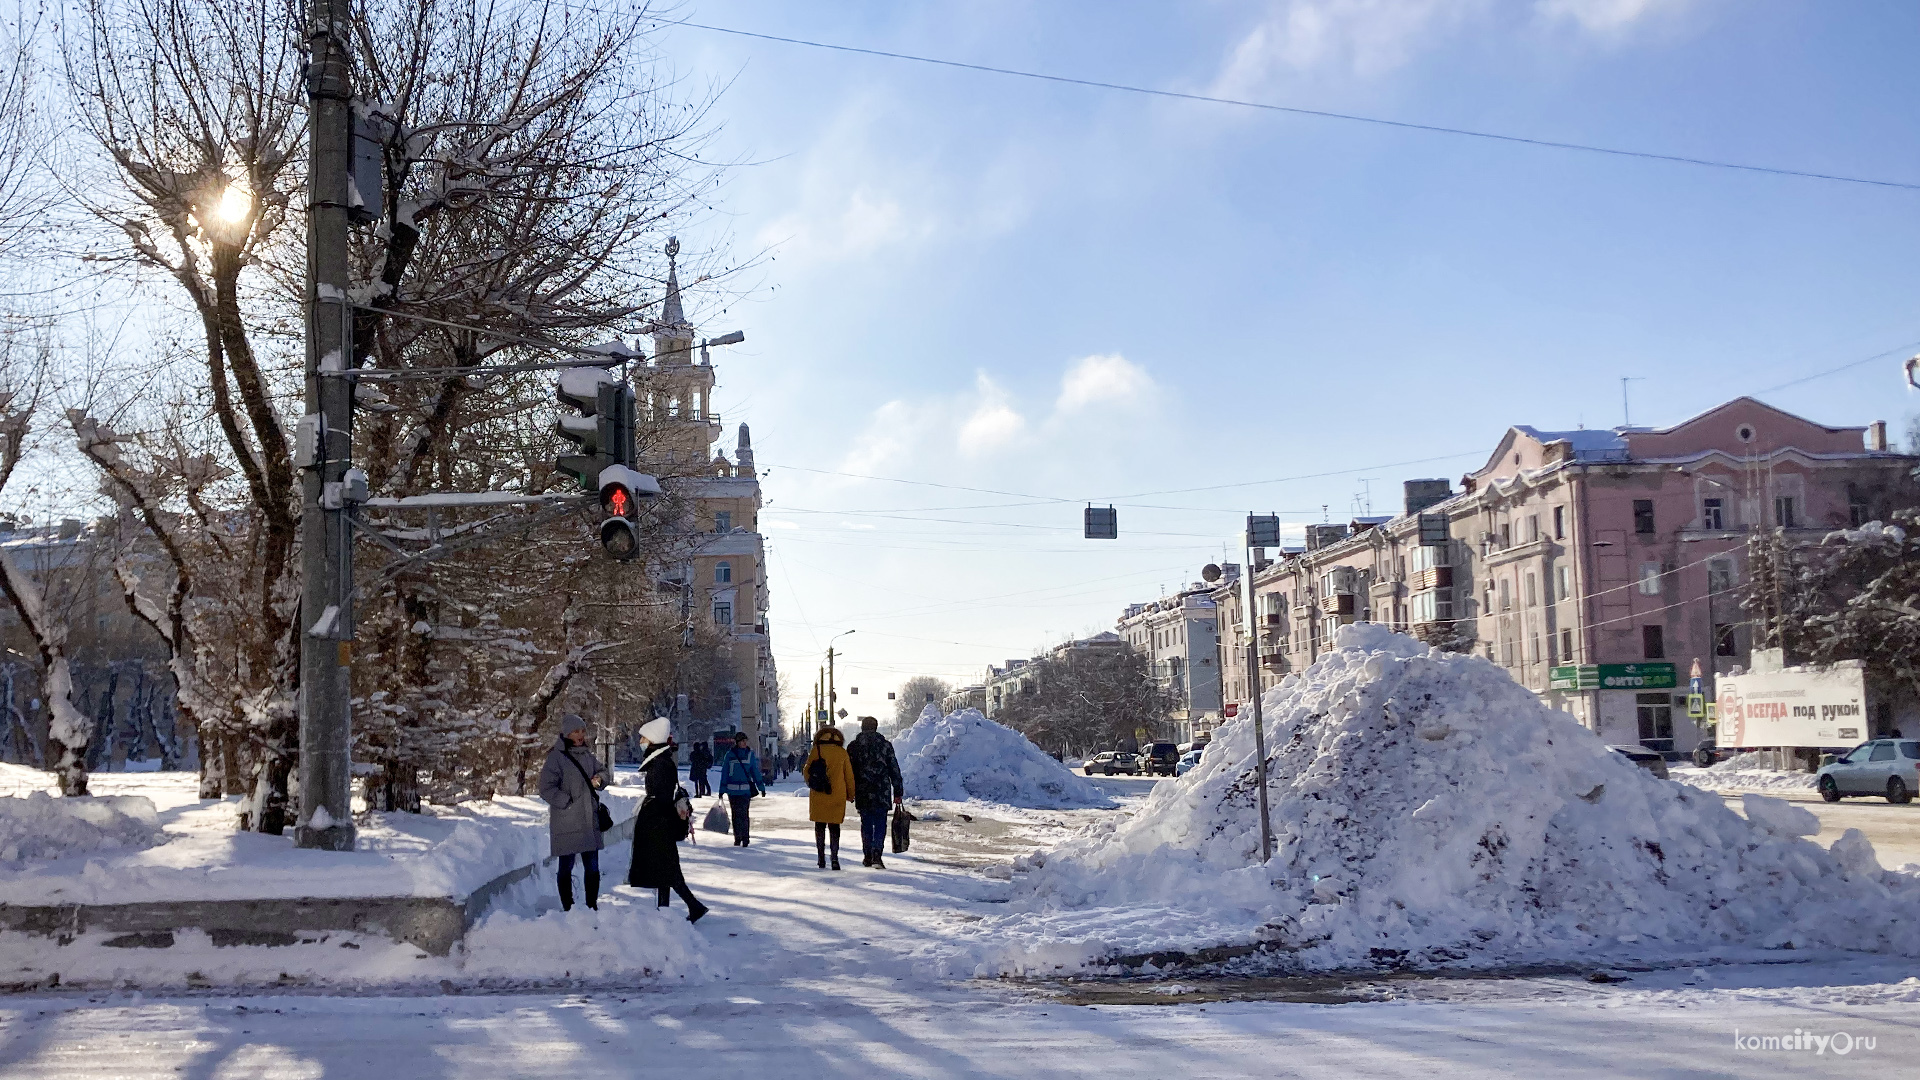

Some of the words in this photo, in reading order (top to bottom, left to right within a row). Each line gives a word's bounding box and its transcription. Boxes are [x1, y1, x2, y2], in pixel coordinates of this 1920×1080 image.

[1746, 702, 1788, 722] ВСЕГДА
[1793, 705, 1817, 720] под
[1822, 699, 1860, 721] рукой
